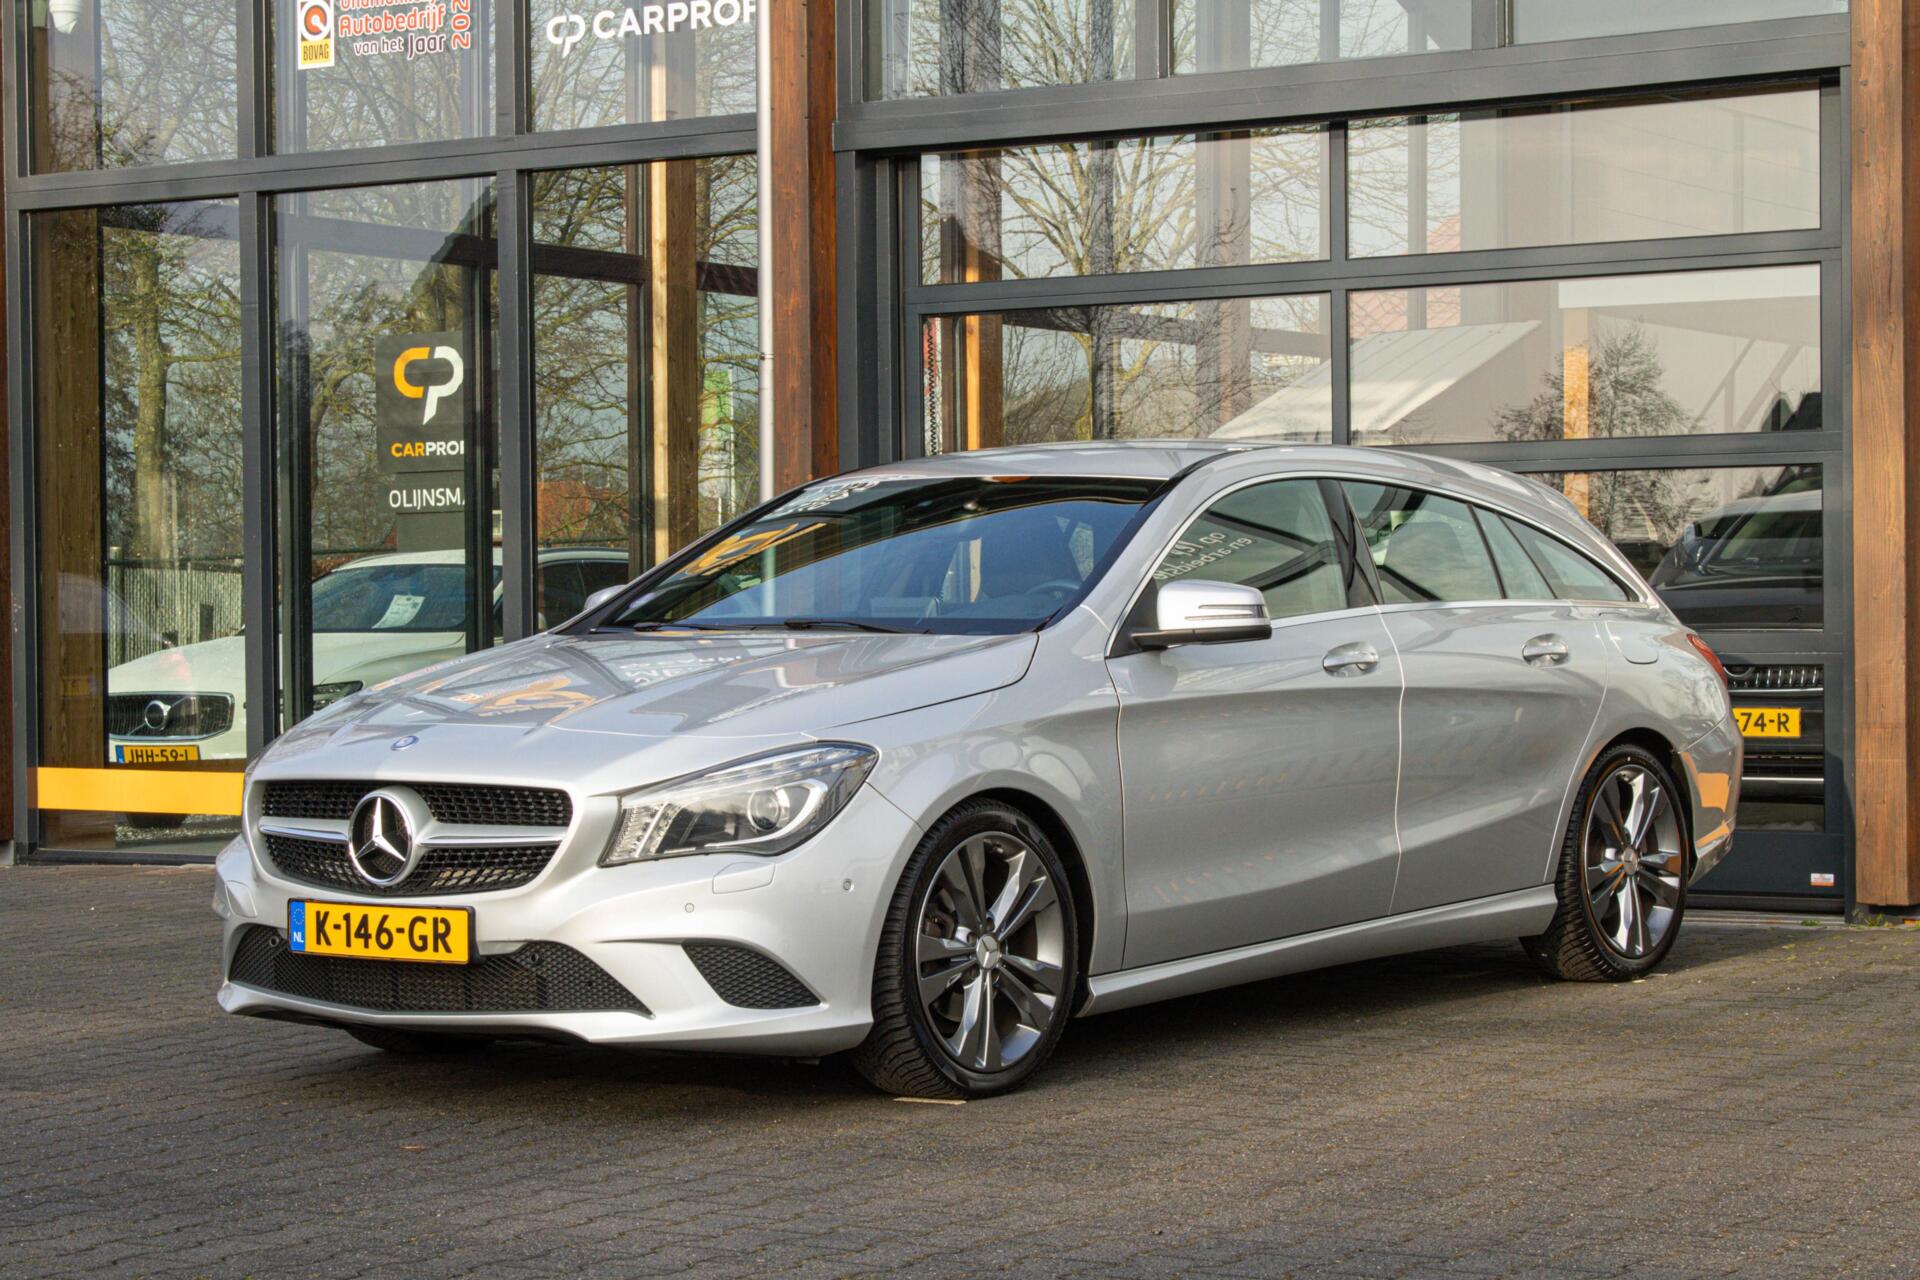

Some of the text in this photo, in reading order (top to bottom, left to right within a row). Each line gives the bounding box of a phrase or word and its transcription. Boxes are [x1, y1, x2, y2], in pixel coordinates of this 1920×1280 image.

[338, 4, 446, 36] Autobedrijf
[303, 43, 329, 61] BOVAG
[354, 33, 446, 59] van het Jaar
[389, 487, 466, 510] OLIJNSM
[293, 931, 304, 943] NL
[315, 910, 453, 954] K-146-GR
